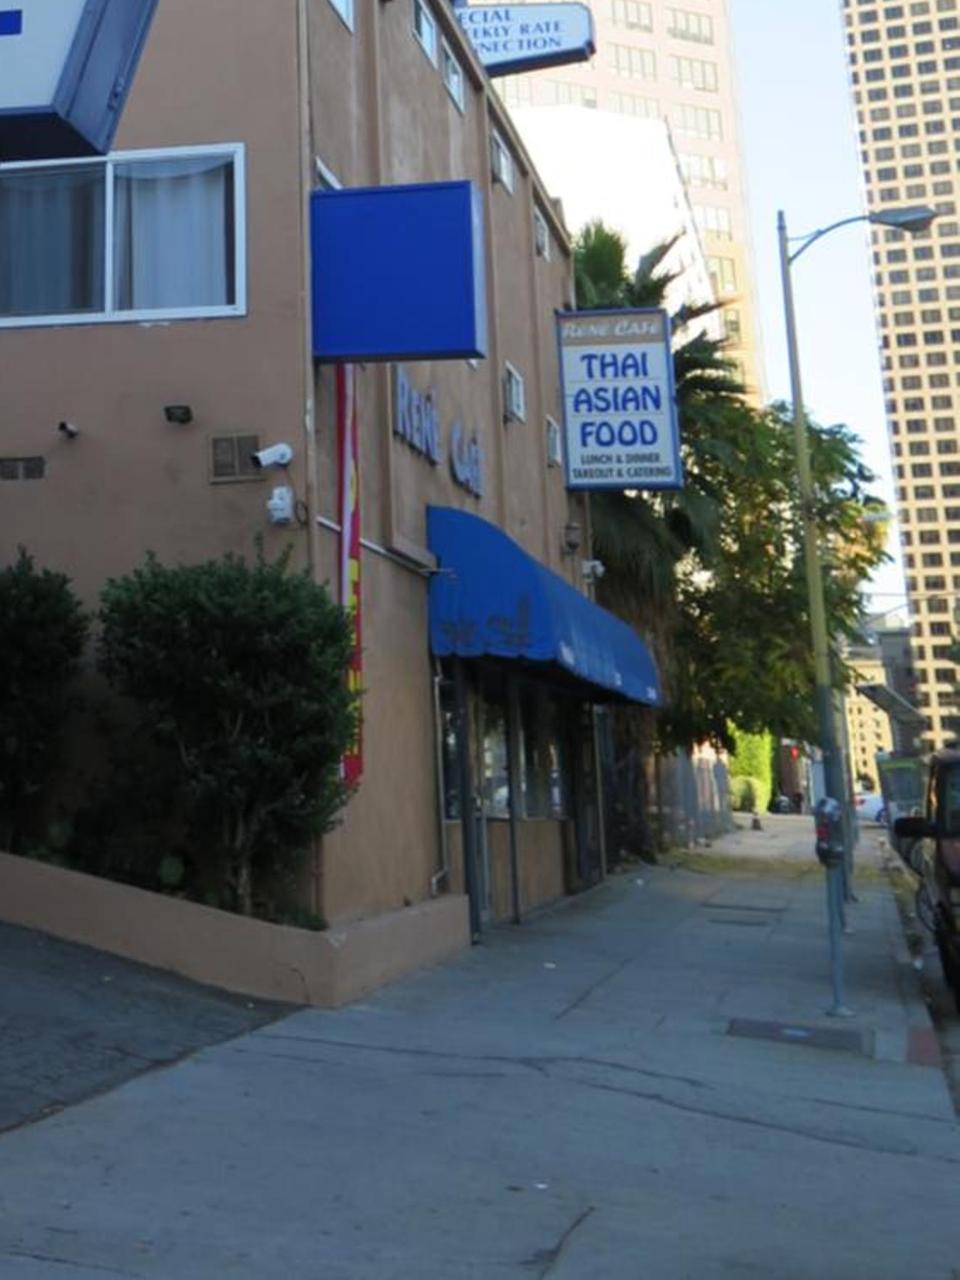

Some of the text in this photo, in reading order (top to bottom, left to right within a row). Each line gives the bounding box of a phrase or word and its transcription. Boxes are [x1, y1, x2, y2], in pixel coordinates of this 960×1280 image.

[580, 351, 649, 379] THAI
[573, 385, 662, 413] ASIAN
[580, 420, 658, 448] FOOD
[573, 468, 614, 479] TAKEOUT
[626, 466, 672, 478] CATERING
[581, 453, 614, 465] LUNCH
[625, 452, 660, 464] DINNER
